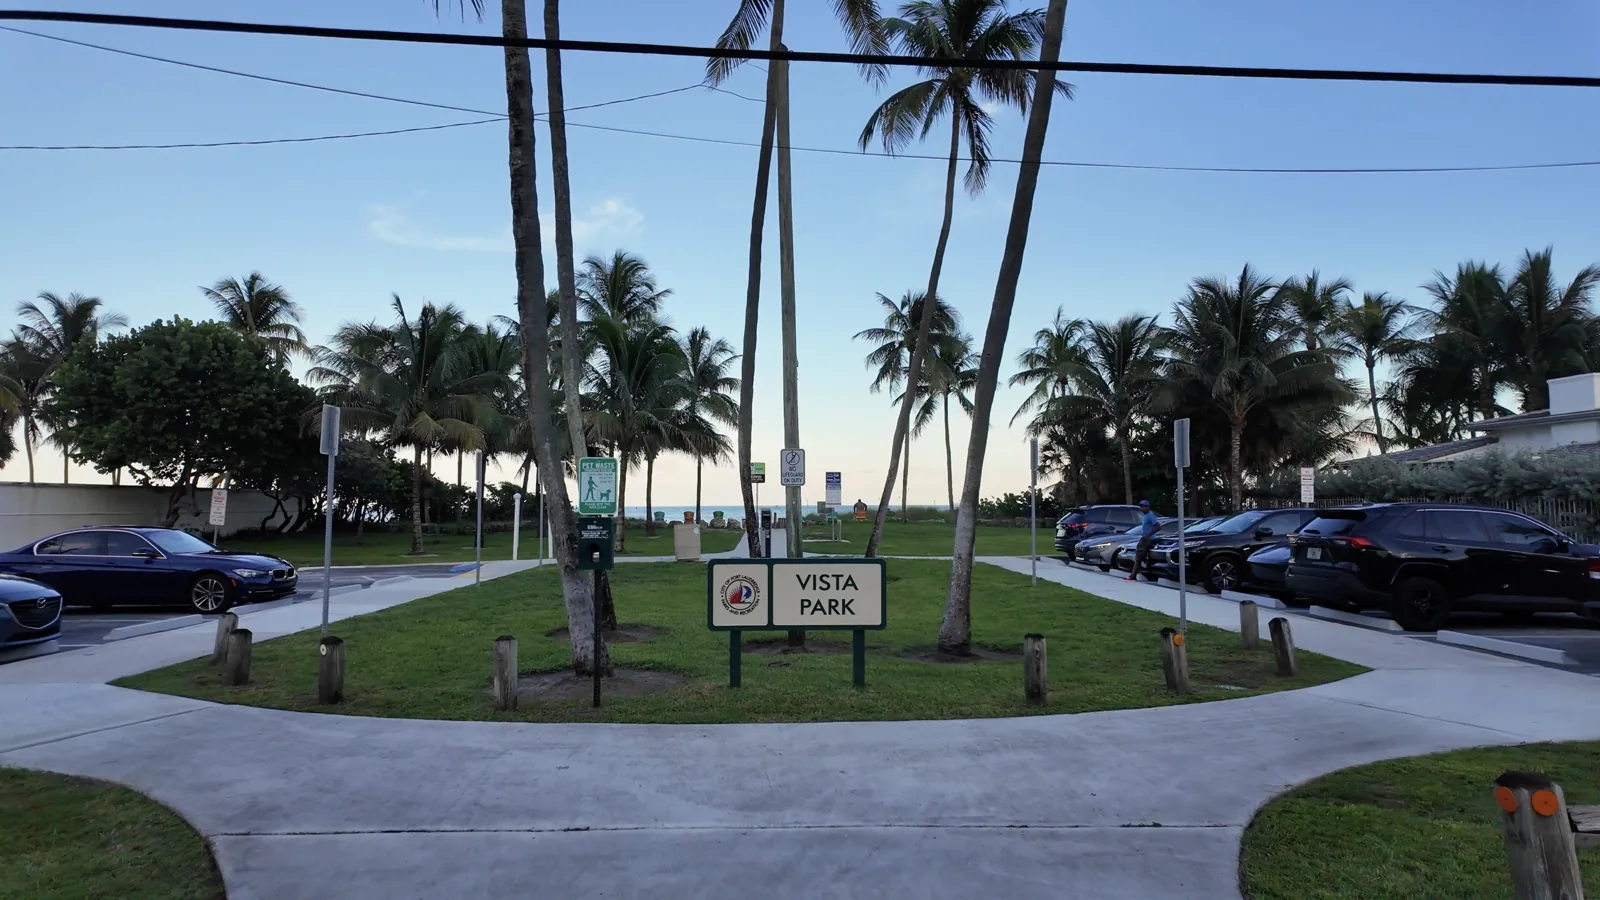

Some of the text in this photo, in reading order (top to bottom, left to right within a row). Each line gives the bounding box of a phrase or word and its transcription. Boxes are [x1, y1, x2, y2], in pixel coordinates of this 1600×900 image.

[741, 574, 761, 594] LAUDERDALE
[796, 574, 859, 591] VISTA
[721, 598, 730, 611] PARKS
[739, 598, 760, 616] RECREATION
[800, 599, 855, 616] PARK
